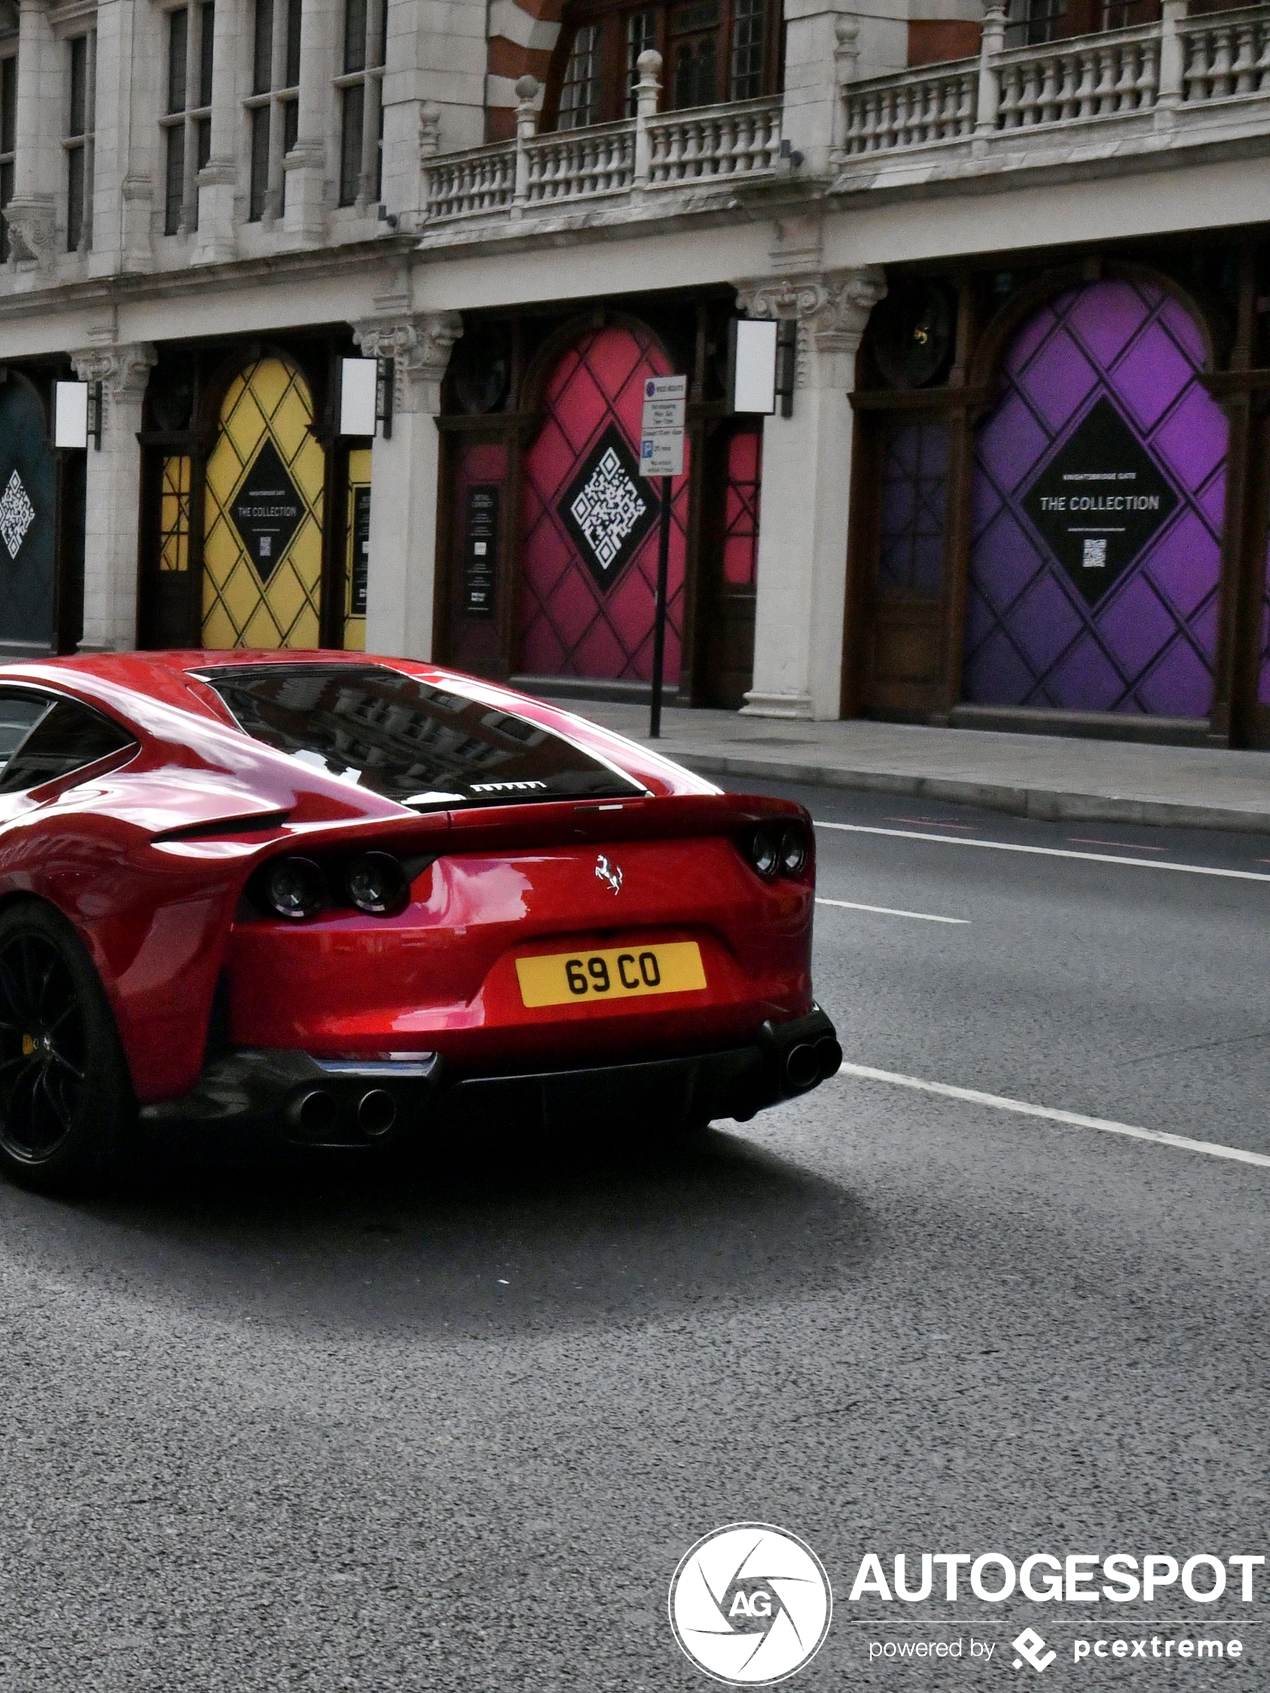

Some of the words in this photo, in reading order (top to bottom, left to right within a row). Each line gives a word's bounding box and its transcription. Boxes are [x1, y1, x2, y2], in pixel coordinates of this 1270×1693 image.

[1040, 497, 1066, 510] THE
[1069, 496, 1160, 511] COLLECTION
[238, 507, 251, 517] THE
[252, 506, 297, 517] COLLECTION
[565, 957, 610, 995] 69
[618, 952, 661, 990] CO
